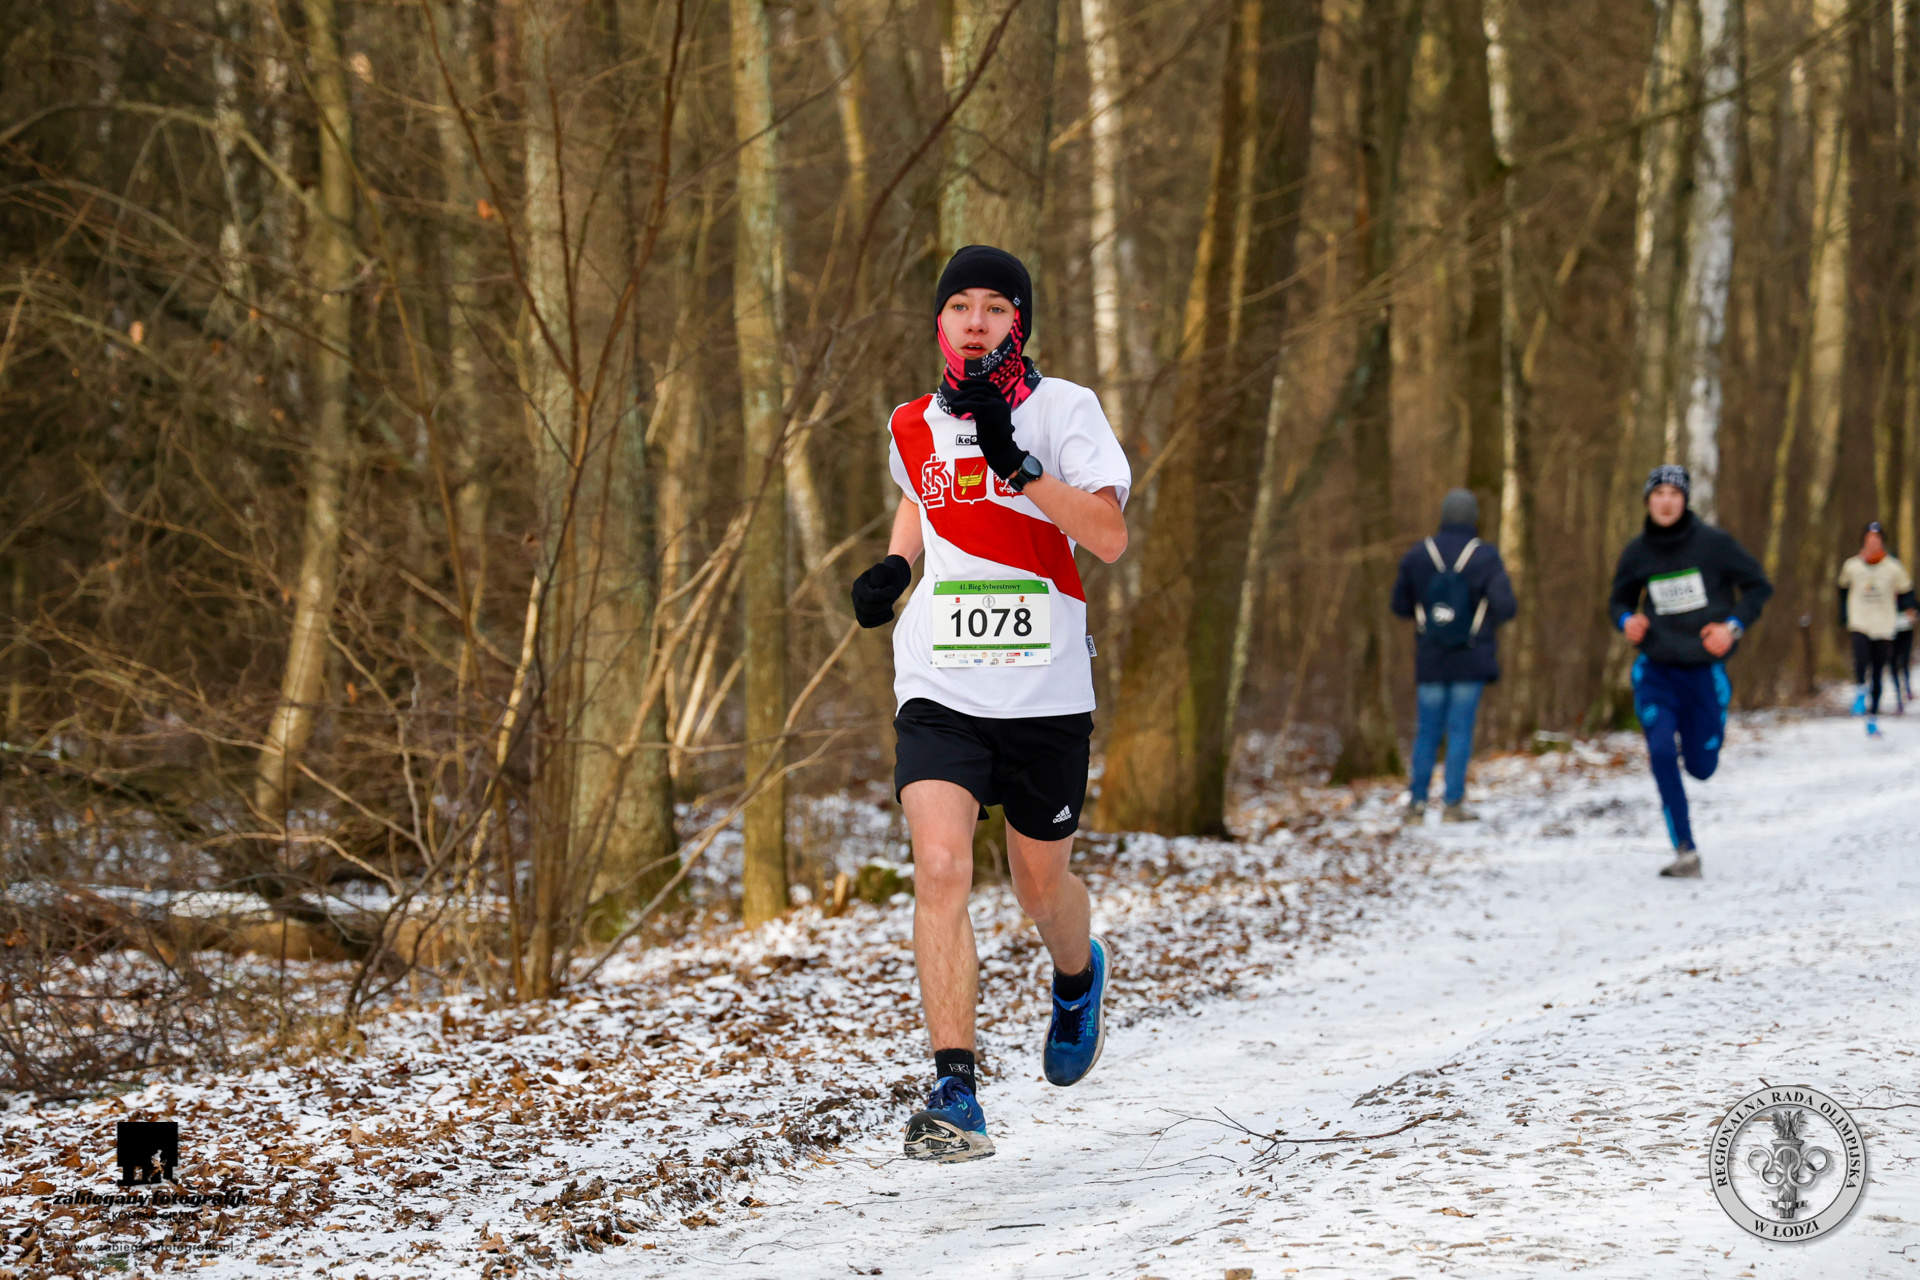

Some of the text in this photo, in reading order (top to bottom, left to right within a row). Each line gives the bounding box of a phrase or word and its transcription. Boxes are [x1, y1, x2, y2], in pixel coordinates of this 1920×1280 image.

[968, 583, 981, 591] Bieg
[951, 608, 1032, 637] 1078
[1086, 1007, 1095, 1037] FILA
